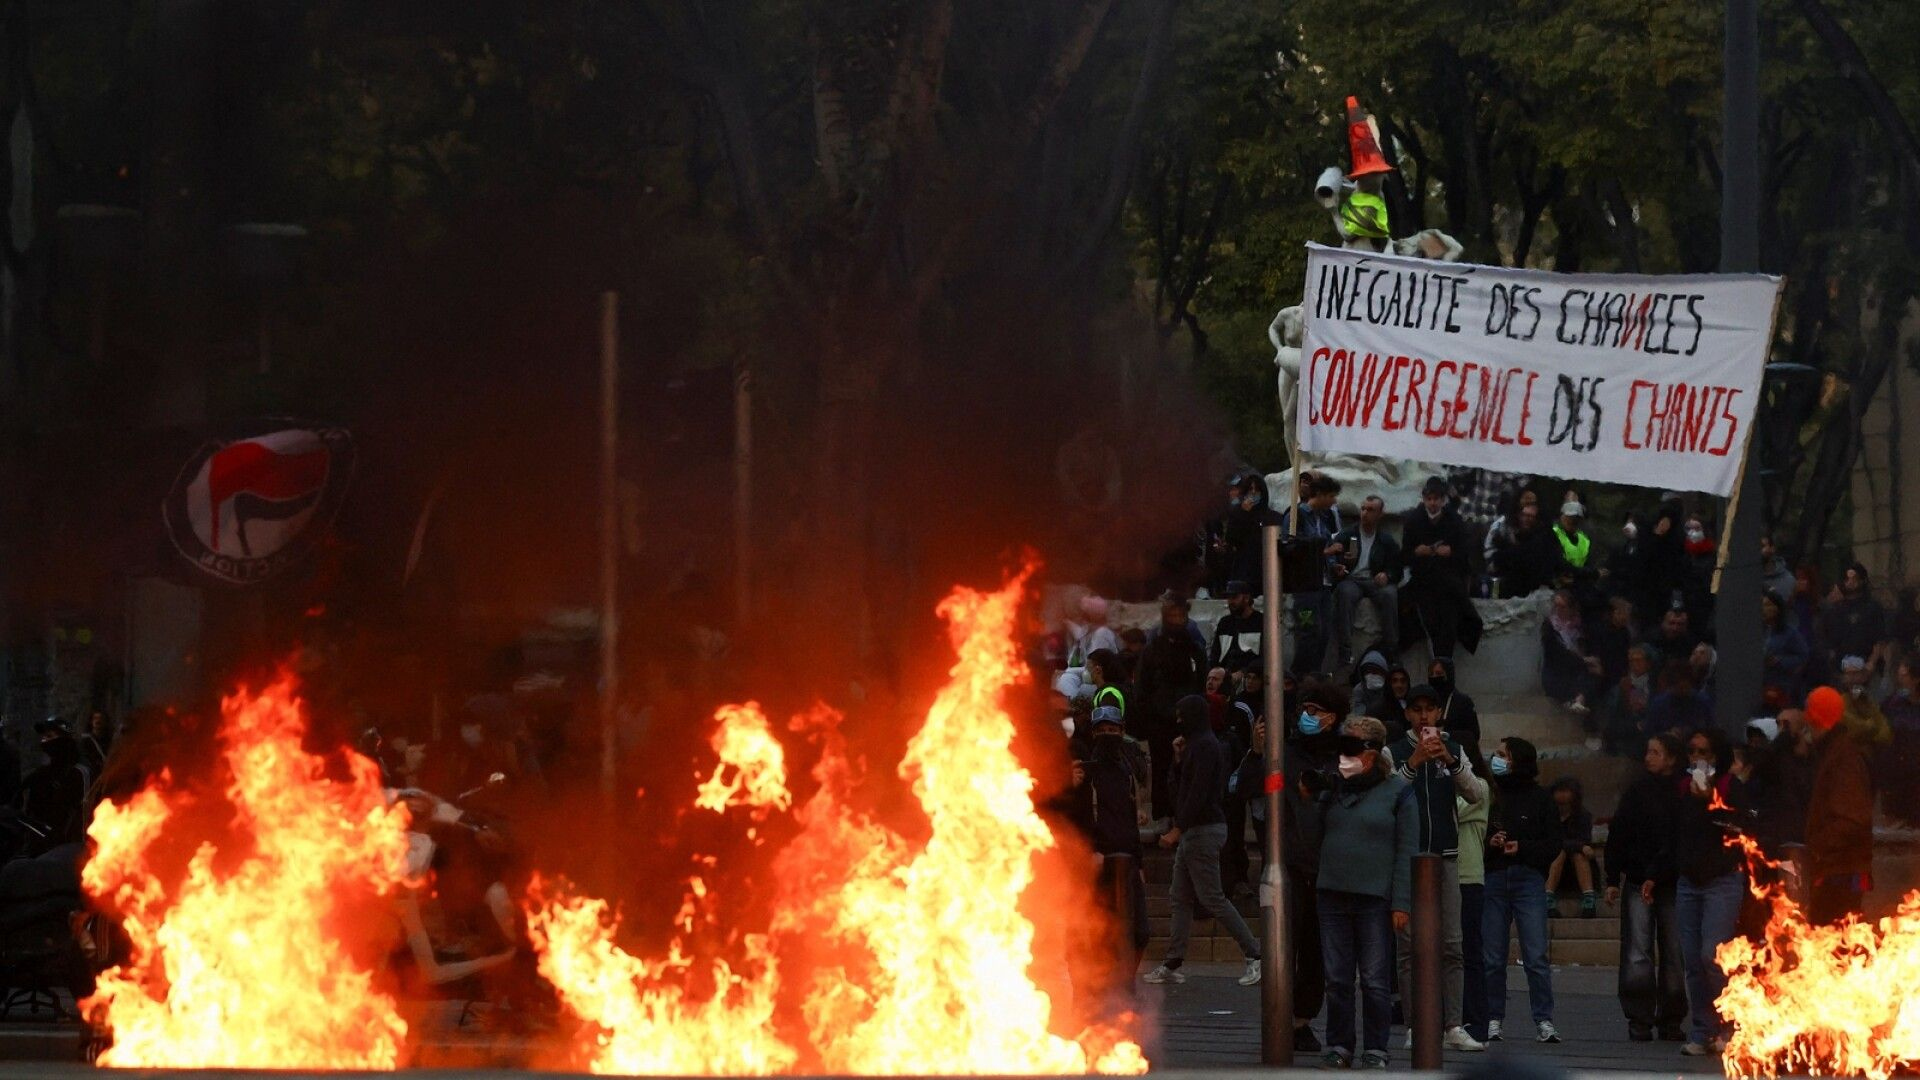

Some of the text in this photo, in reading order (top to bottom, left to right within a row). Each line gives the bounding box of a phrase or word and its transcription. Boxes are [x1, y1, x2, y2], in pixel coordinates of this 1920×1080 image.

[1316, 259, 1475, 333] INÉGALITÉ
[1486, 283, 1541, 340] DES
[1309, 347, 1743, 456] CONVERGENCE DES CHANTS
